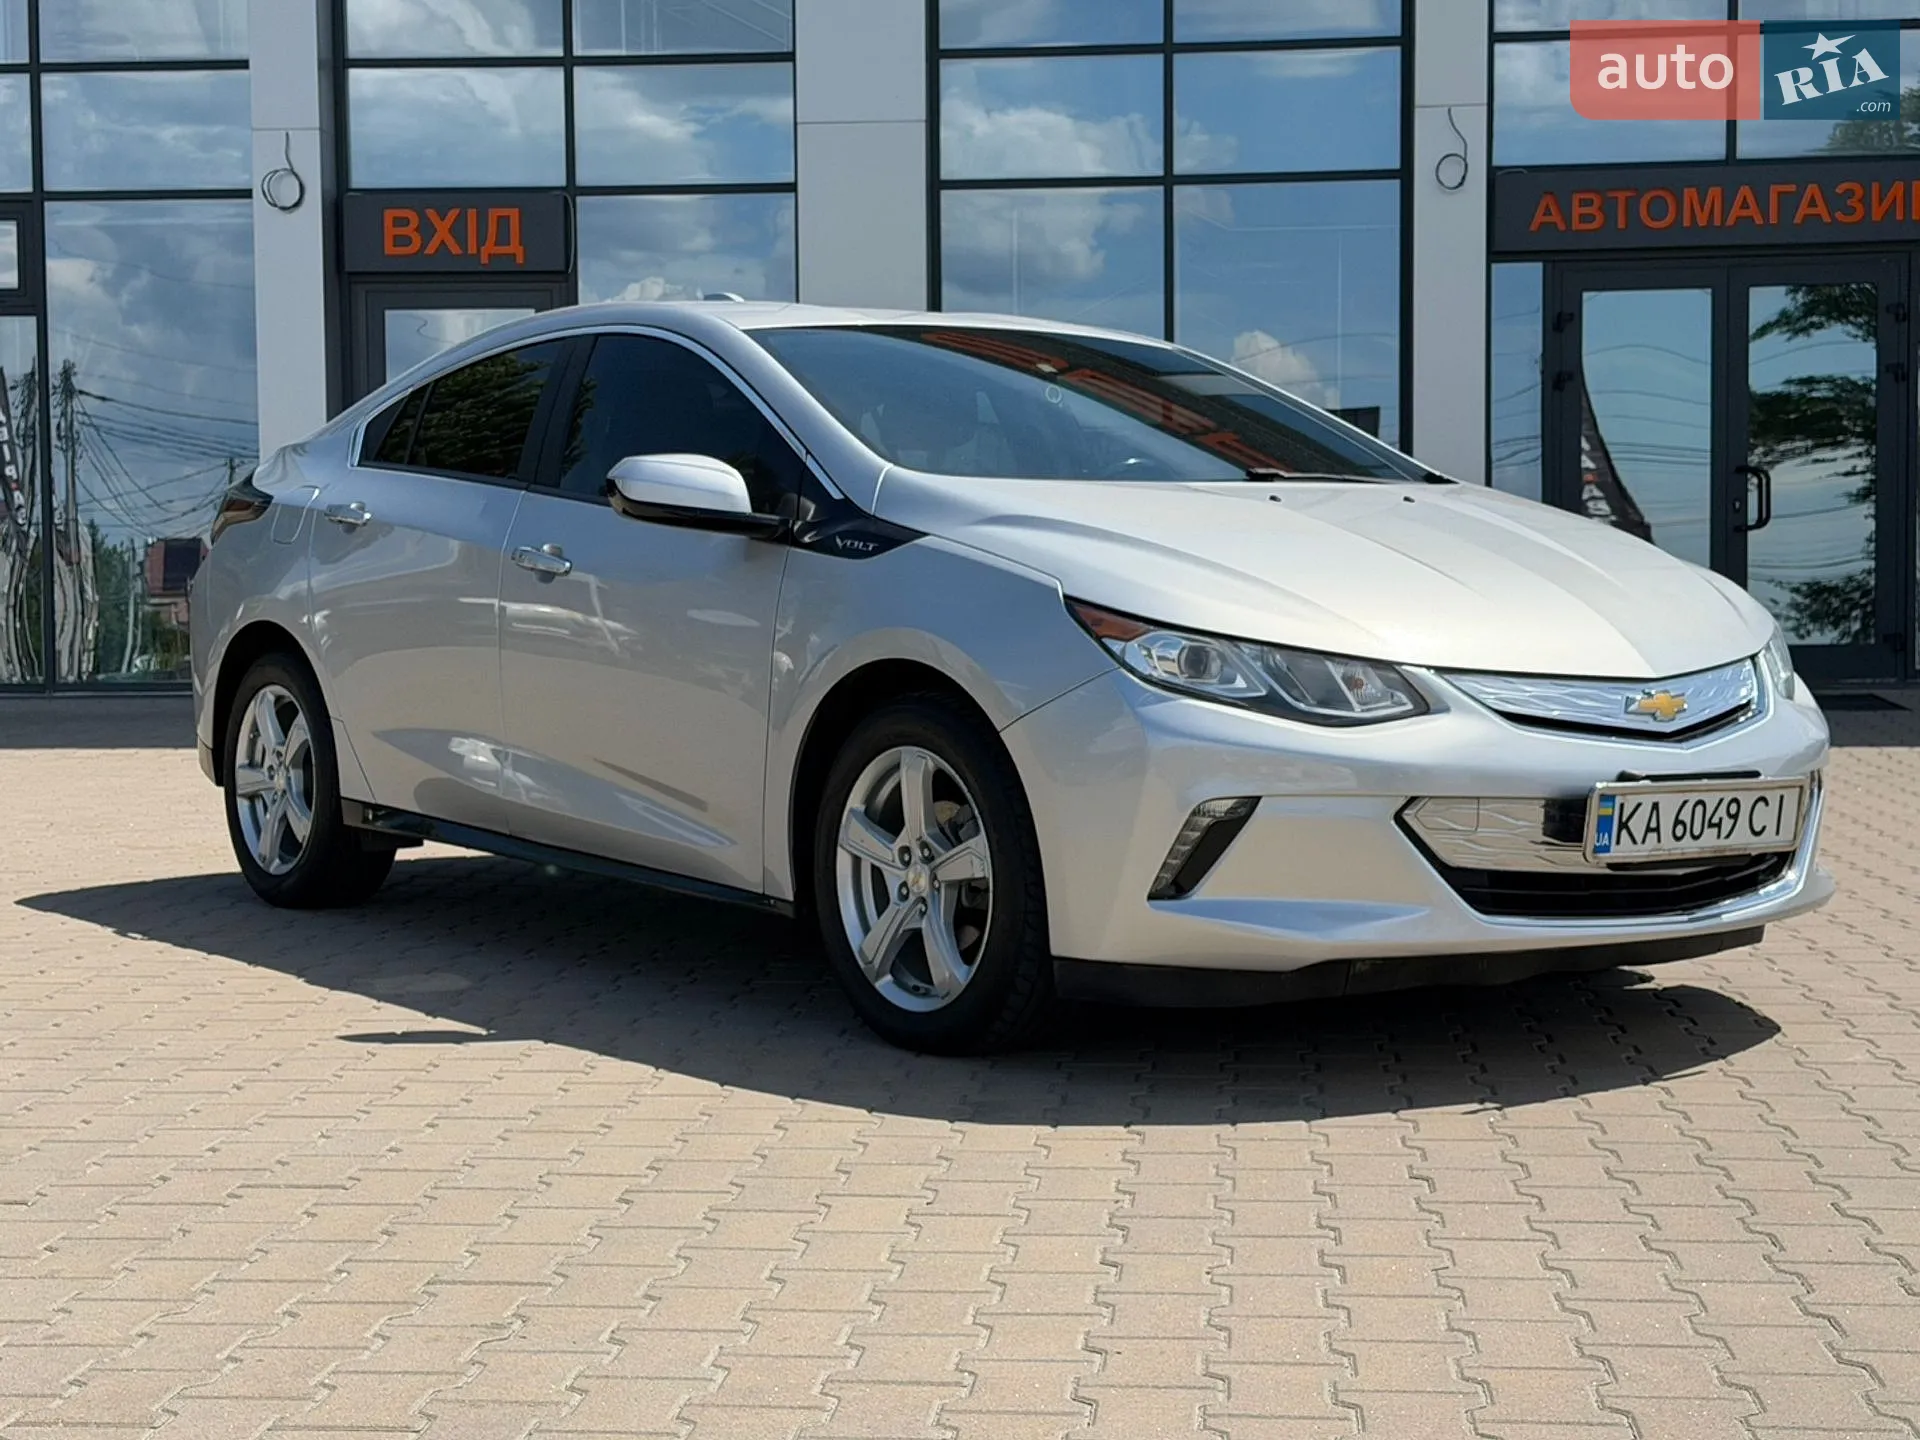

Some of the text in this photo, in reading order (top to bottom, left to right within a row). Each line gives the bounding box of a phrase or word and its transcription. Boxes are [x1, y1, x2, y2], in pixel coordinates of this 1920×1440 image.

[383, 208, 525, 264] ВХІД
[836, 535, 879, 551] VOLT
[1616, 794, 1785, 846] KA 6049 CI
[1595, 832, 1610, 847] UA
